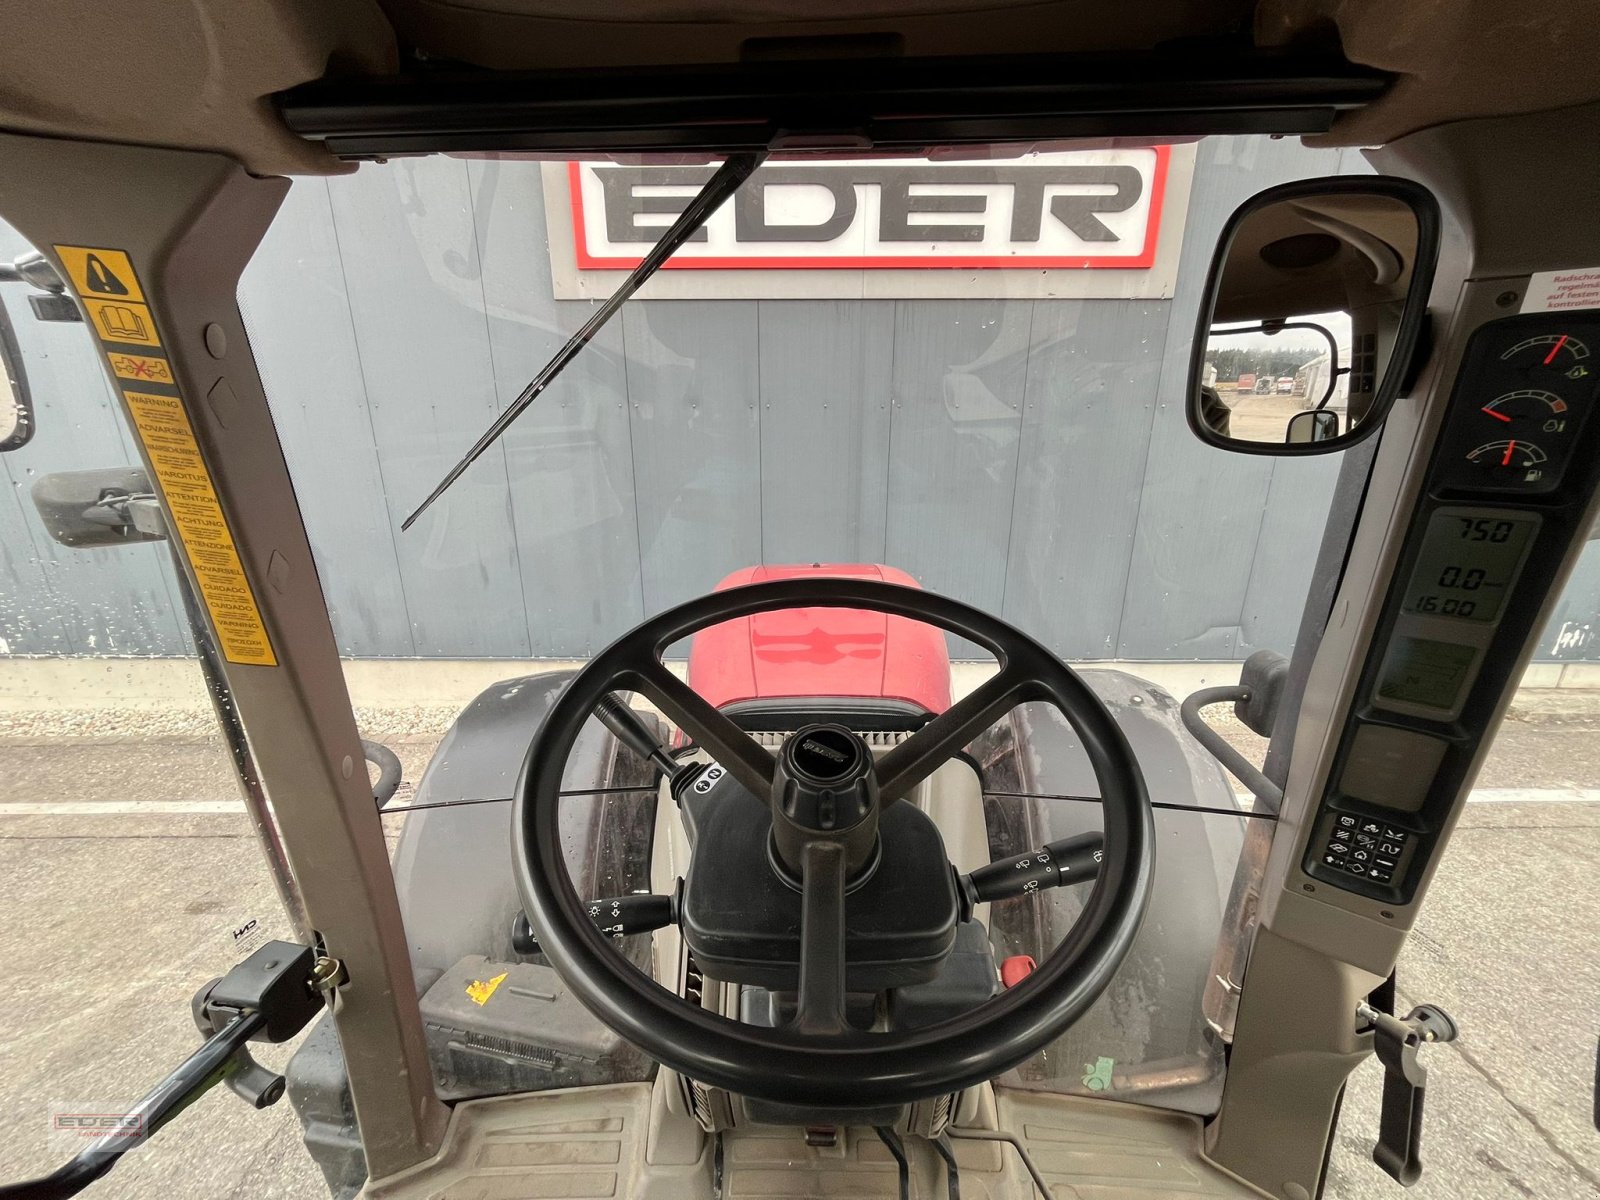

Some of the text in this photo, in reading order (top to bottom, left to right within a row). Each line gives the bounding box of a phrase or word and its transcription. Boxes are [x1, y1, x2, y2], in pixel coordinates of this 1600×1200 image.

[590, 165, 1143, 243] EDER
[1547, 291, 1599, 300] auf festen
[129, 395, 179, 409] WARNING
[138, 423, 192, 437] ADVARSEL
[158, 470, 208, 482] VAROITUS
[166, 491, 218, 504] ATTENTION
[177, 515, 224, 528] ACHTUNG
[1460, 518, 1515, 543] 750
[184, 539, 235, 551] ATTENZIONE
[194, 564, 243, 576] ADVARSEL
[203, 583, 247, 594] CUIDADO
[210, 601, 253, 612] CUIDADO
